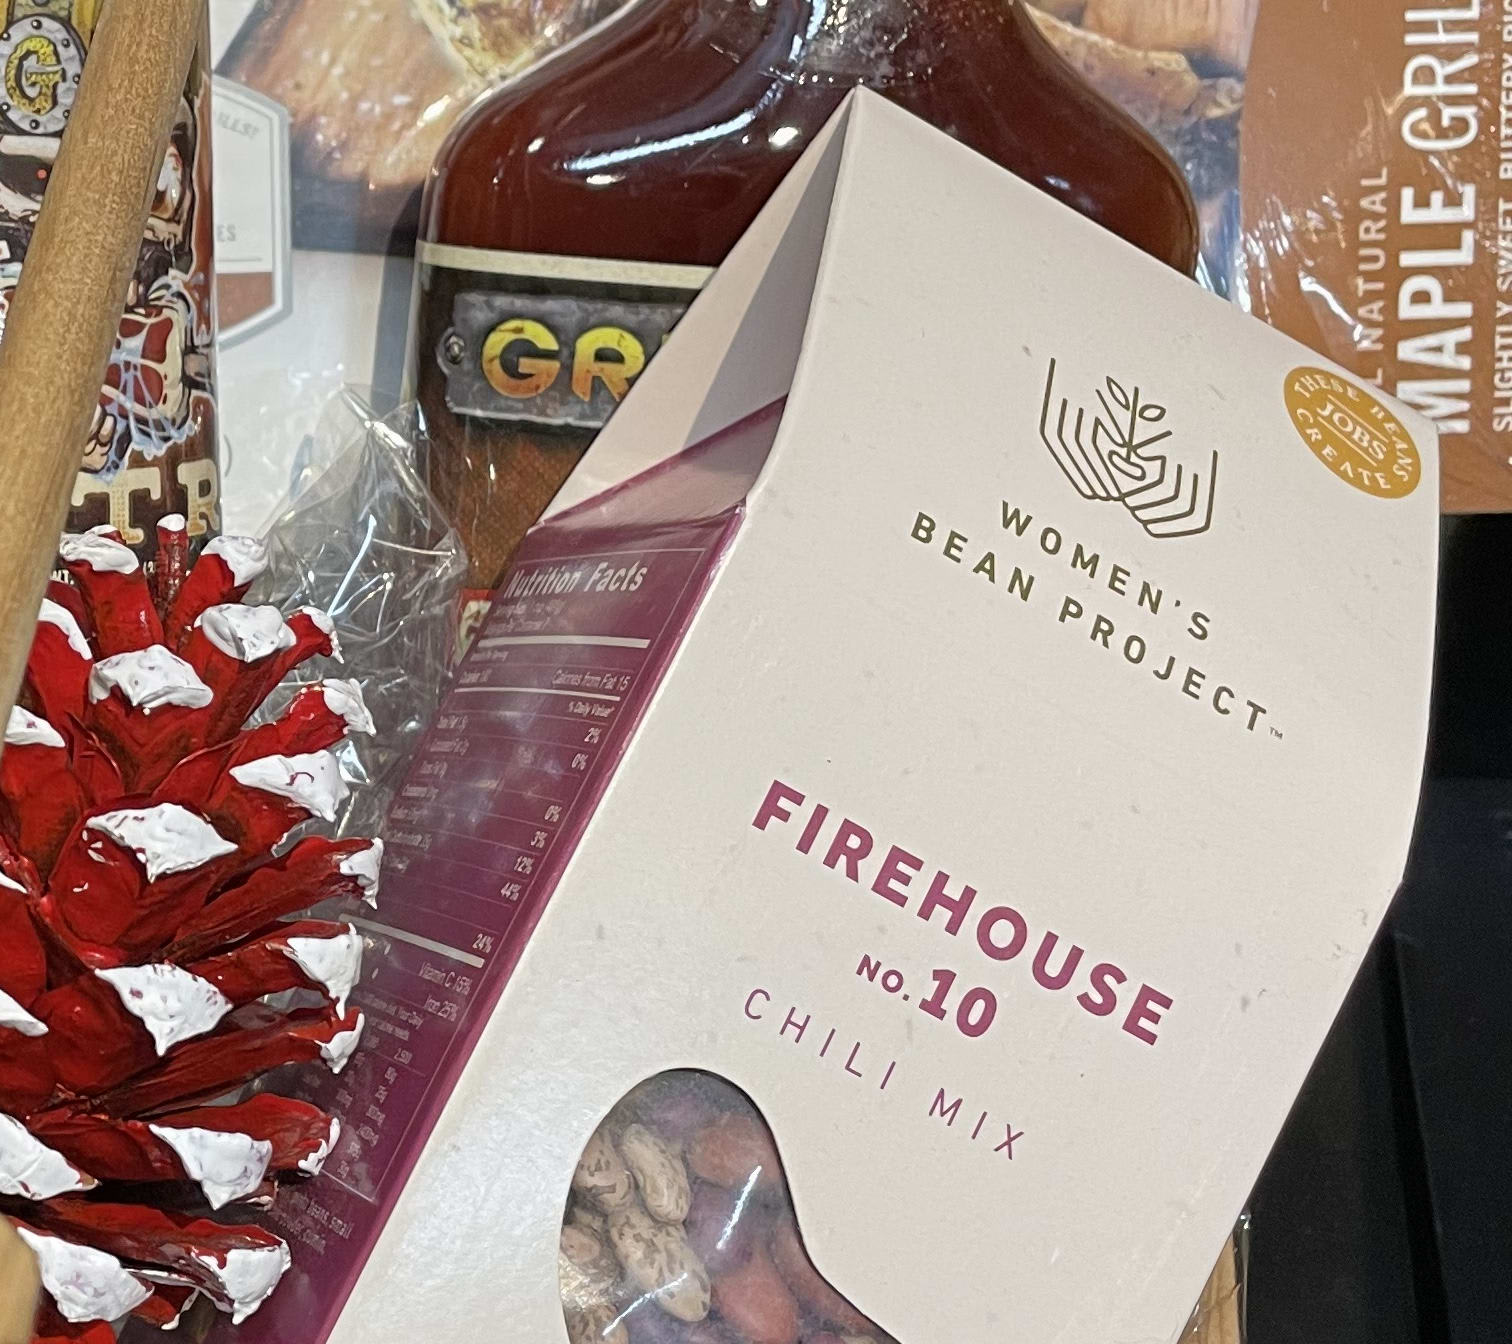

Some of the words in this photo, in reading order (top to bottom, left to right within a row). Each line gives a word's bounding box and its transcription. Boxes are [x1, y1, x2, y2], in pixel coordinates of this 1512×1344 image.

[1357, 166, 1390, 350] NATURAL
[1397, 181, 1477, 433] MAPLE
[1294, 374, 1360, 402] THESE
[1296, 408, 1392, 489] CREATE
[1316, 402, 1387, 460] JOBS
[504, 565, 583, 599] Nutrition
[584, 560, 648, 593] Facts
[910, 511, 1035, 602] BEAN
[1058, 595, 1267, 732] PROJECT
[1001, 500, 1211, 641] WOMEN'S
[751, 779, 1175, 1047] FIREHOUSE
[744, 988, 896, 1090] CHILI
[929, 1088, 1025, 1161] MIX
